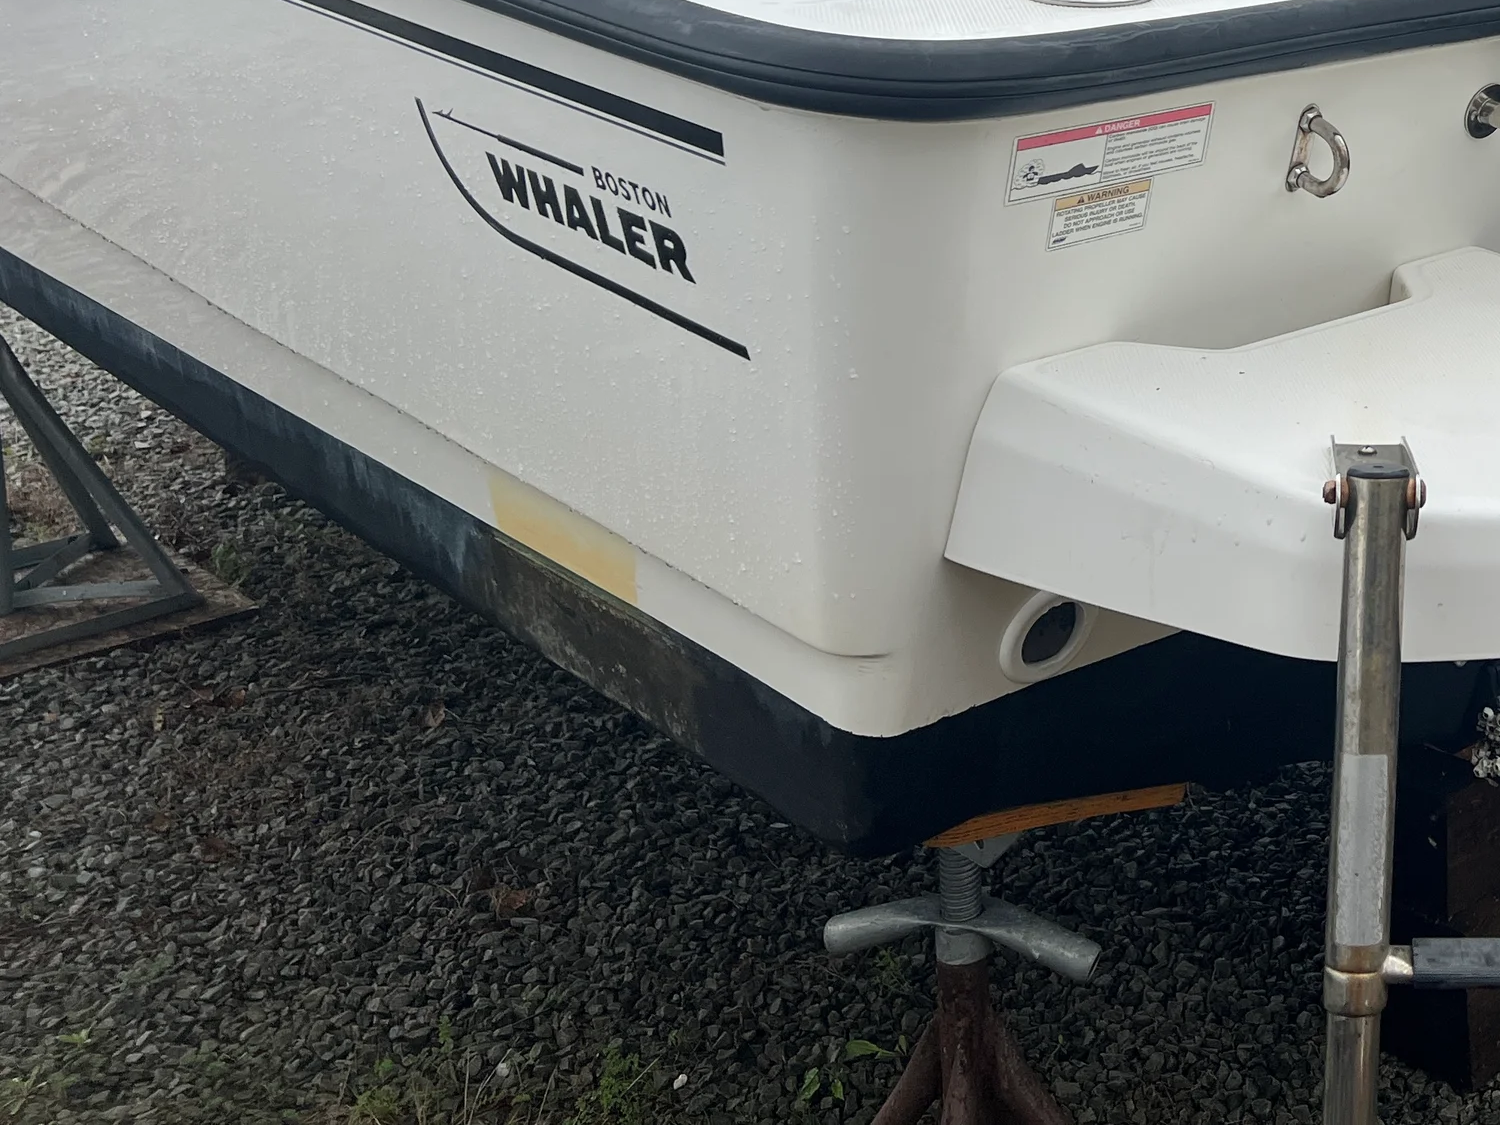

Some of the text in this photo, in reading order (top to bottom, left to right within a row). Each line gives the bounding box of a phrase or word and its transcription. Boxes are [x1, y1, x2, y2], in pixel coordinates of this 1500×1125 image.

[1105, 120, 1141, 132] DANGER
[591, 165, 672, 218] BOSTON
[1087, 186, 1130, 202] WARNING
[1056, 207, 1084, 217] ROTATING
[1084, 200, 1115, 211] PROPELLER
[1129, 193, 1146, 201] CAUSE
[485, 151, 697, 285] WHALER
[1065, 212, 1088, 222] SERIOUS
[1089, 208, 1108, 216] INJURY
[1085, 213, 1115, 224] APPROACH
[1052, 228, 1074, 238] LADDER
[1075, 224, 1091, 233] WHEN
[1092, 220, 1112, 229] ENGINE
